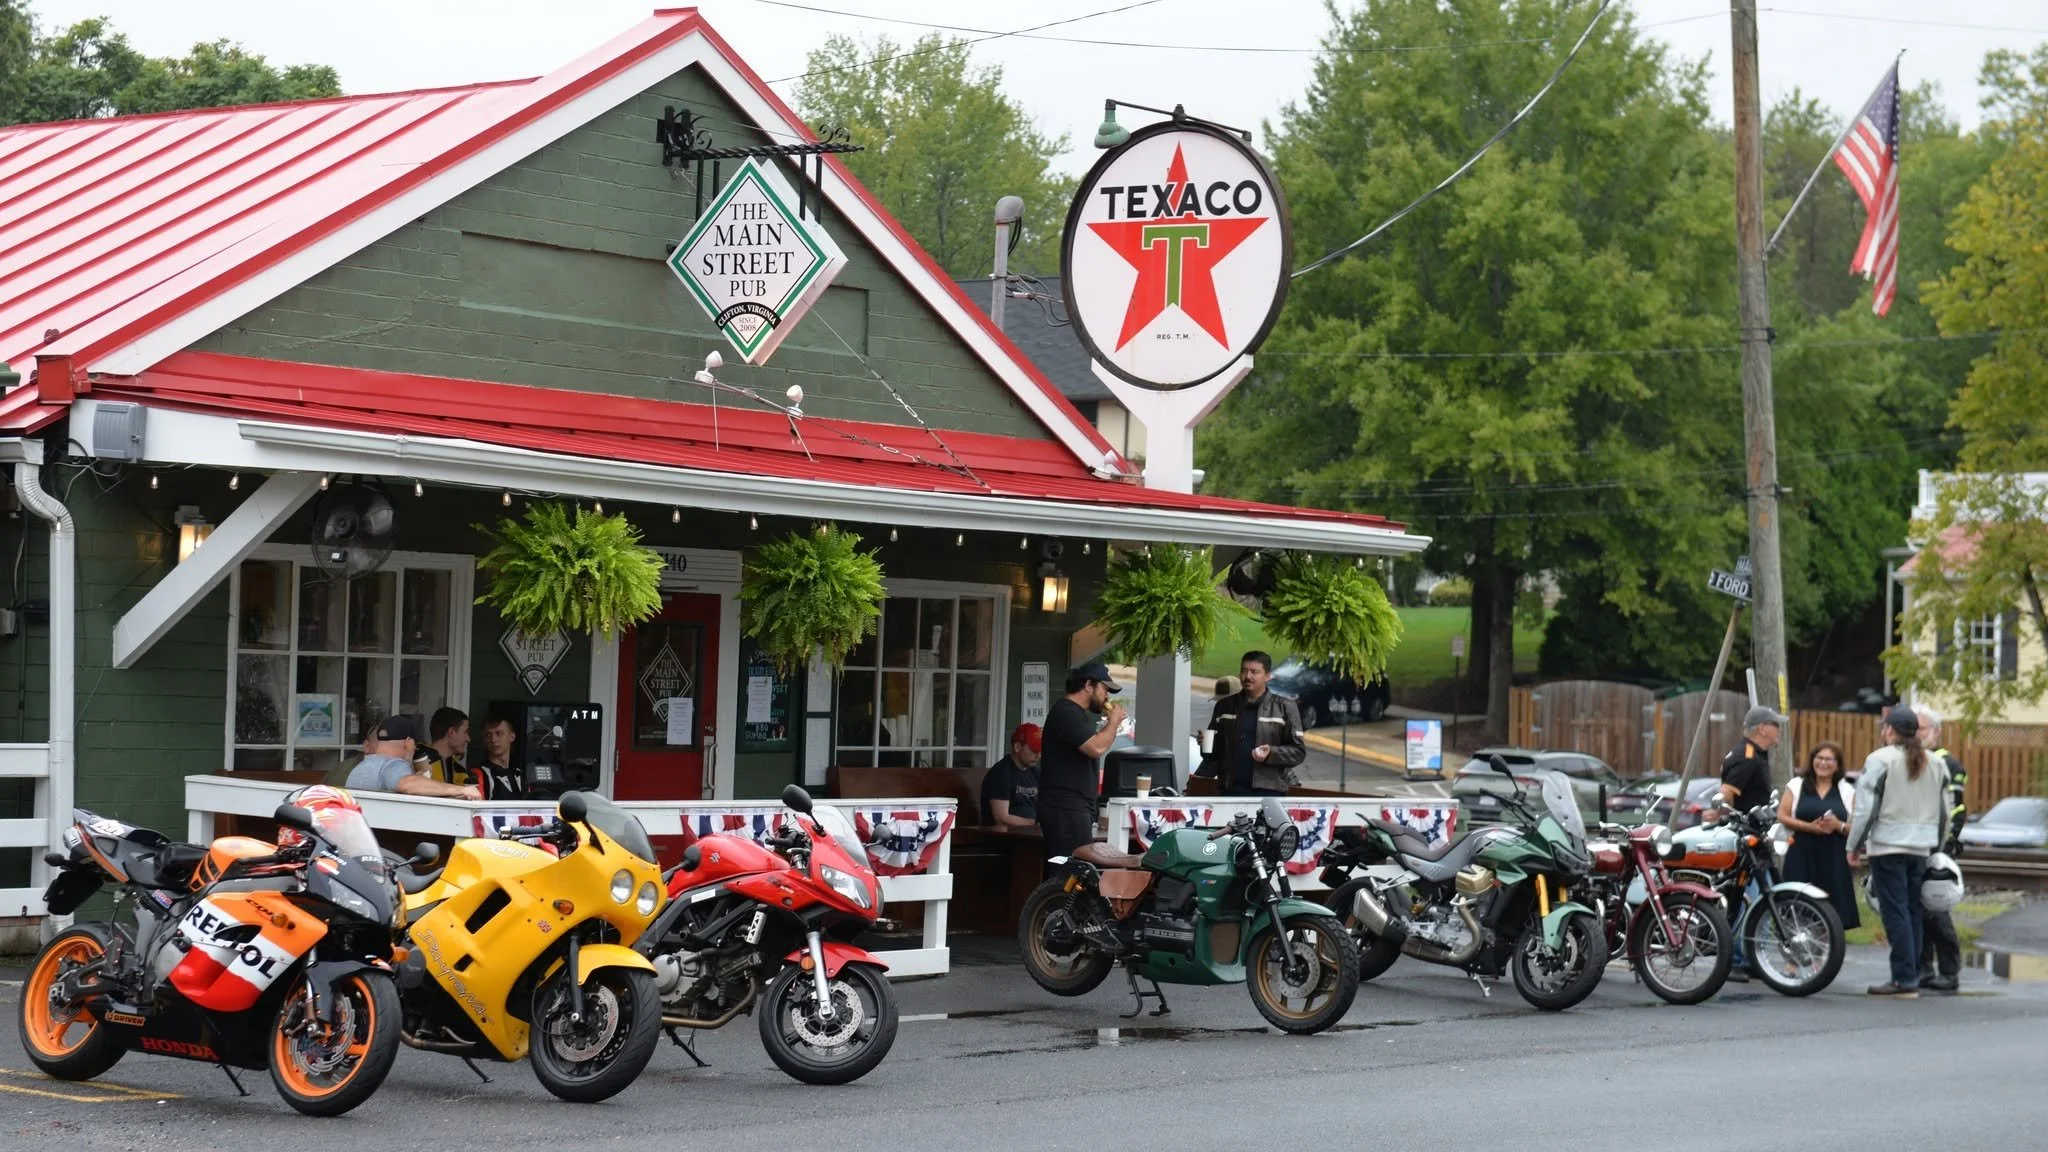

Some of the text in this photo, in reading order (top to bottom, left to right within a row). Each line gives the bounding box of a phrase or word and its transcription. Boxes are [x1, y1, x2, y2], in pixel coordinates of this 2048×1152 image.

[1100, 179, 1262, 220] TEXACO
[729, 203, 769, 221] THE
[714, 223, 784, 247] MAIN
[702, 251, 795, 276] STREET
[1142, 223, 1210, 309] T
[729, 279, 767, 297] PUB
[717, 304, 777, 327] CLIFTON, VIRGINIA
[738, 316, 757, 324] SINCE
[740, 324, 757, 332] 2008
[1156, 333, 1174, 341] REG.
[1715, 573, 1749, 597] FORD
[515, 639, 556, 652] STREET
[527, 652, 545, 662] PUB
[654, 668, 678, 678] MAIN
[650, 679, 681, 689] STREET
[571, 709, 598, 720] ATM
[141, 1037, 221, 1062] HONDA
